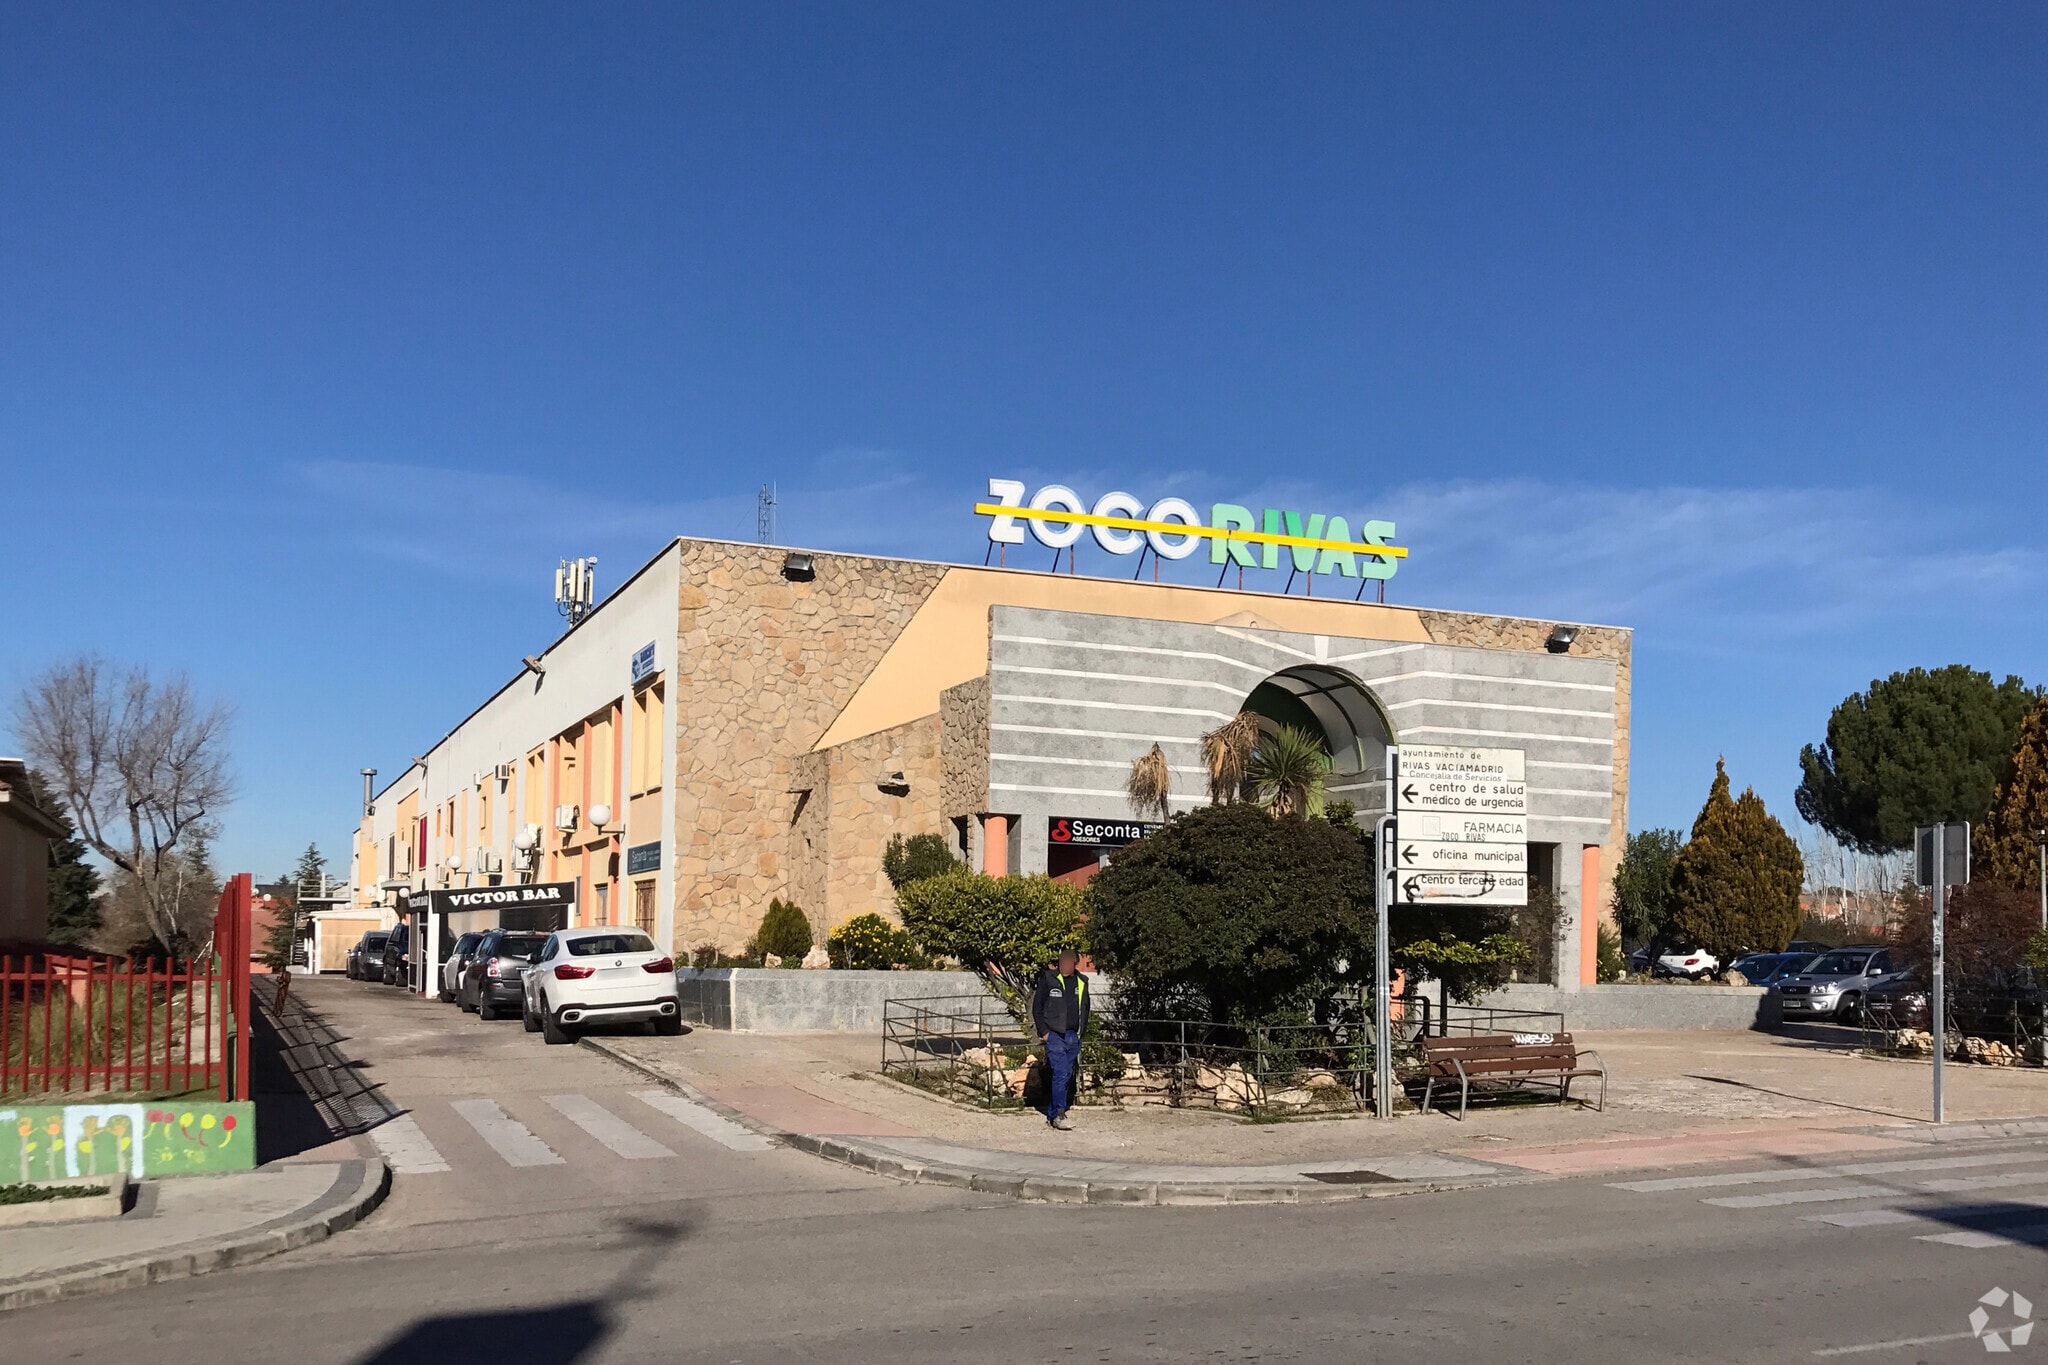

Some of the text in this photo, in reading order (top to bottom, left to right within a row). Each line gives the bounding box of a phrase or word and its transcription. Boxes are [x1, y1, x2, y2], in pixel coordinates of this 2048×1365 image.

[989, 478, 1399, 580] ZOCO RIVAS
[1402, 749, 1482, 760] ayuntamiento de
[1402, 761, 1504, 774] RIVAS VACIAMADRID
[1453, 773, 1463, 781] de
[1464, 773, 1502, 783] Servicios
[1429, 782, 1524, 795] centro de salud
[1422, 794, 1524, 809] médico de urgencia
[1072, 820, 1141, 839] Seconta
[1463, 821, 1524, 835] FARMACIA
[1441, 831, 1486, 843] ZOCO RIVAS
[1432, 848, 1524, 864] oficina municipal
[1421, 873, 1455, 885] centro
[1499, 875, 1524, 886] edad
[449, 887, 561, 906] VICTOR BAR
